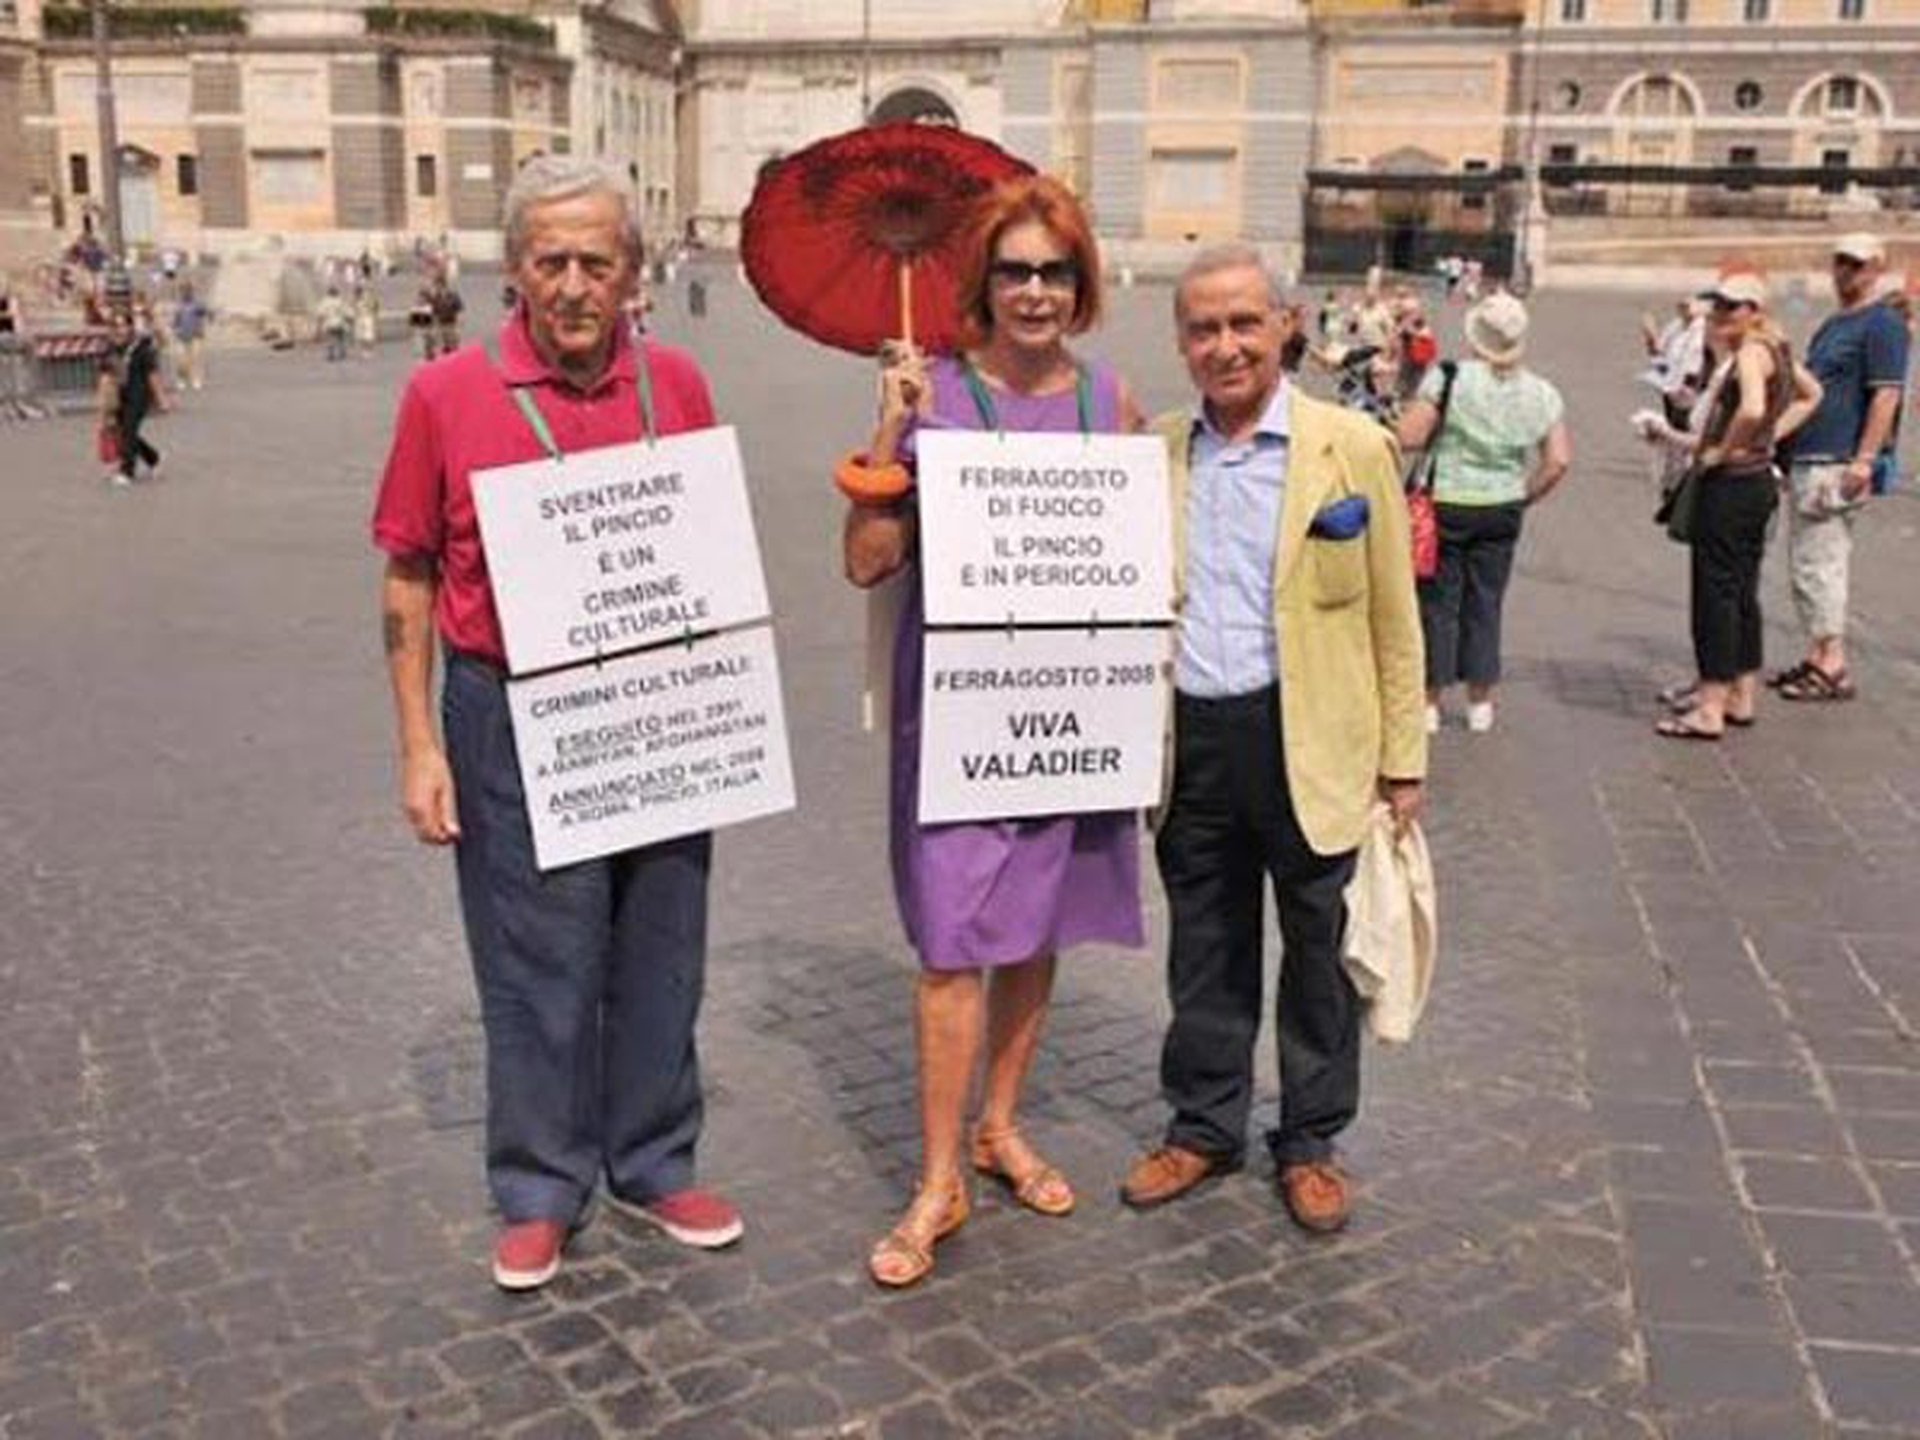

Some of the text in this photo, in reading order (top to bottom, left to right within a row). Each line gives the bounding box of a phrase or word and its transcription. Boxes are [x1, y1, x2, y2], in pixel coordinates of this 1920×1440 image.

[960, 467, 1129, 491] FERRAGOSTO
[538, 473, 685, 520] SVENTRARE
[988, 497, 1104, 518] DI FUOCO
[562, 504, 673, 544] IL PINCIO
[619, 544, 655, 570] UN
[993, 536, 1103, 558] IL PINCIO
[983, 563, 1009, 587] IN
[1013, 563, 1140, 587] PERICOLO
[583, 575, 683, 615] CRIMINE
[567, 598, 710, 647] CULTURALE
[933, 664, 1155, 692] FERRAGOSTO 2008
[530, 683, 619, 719] CRIMINI
[1008, 711, 1081, 739] VIVA
[961, 748, 1122, 781] VALADIER
